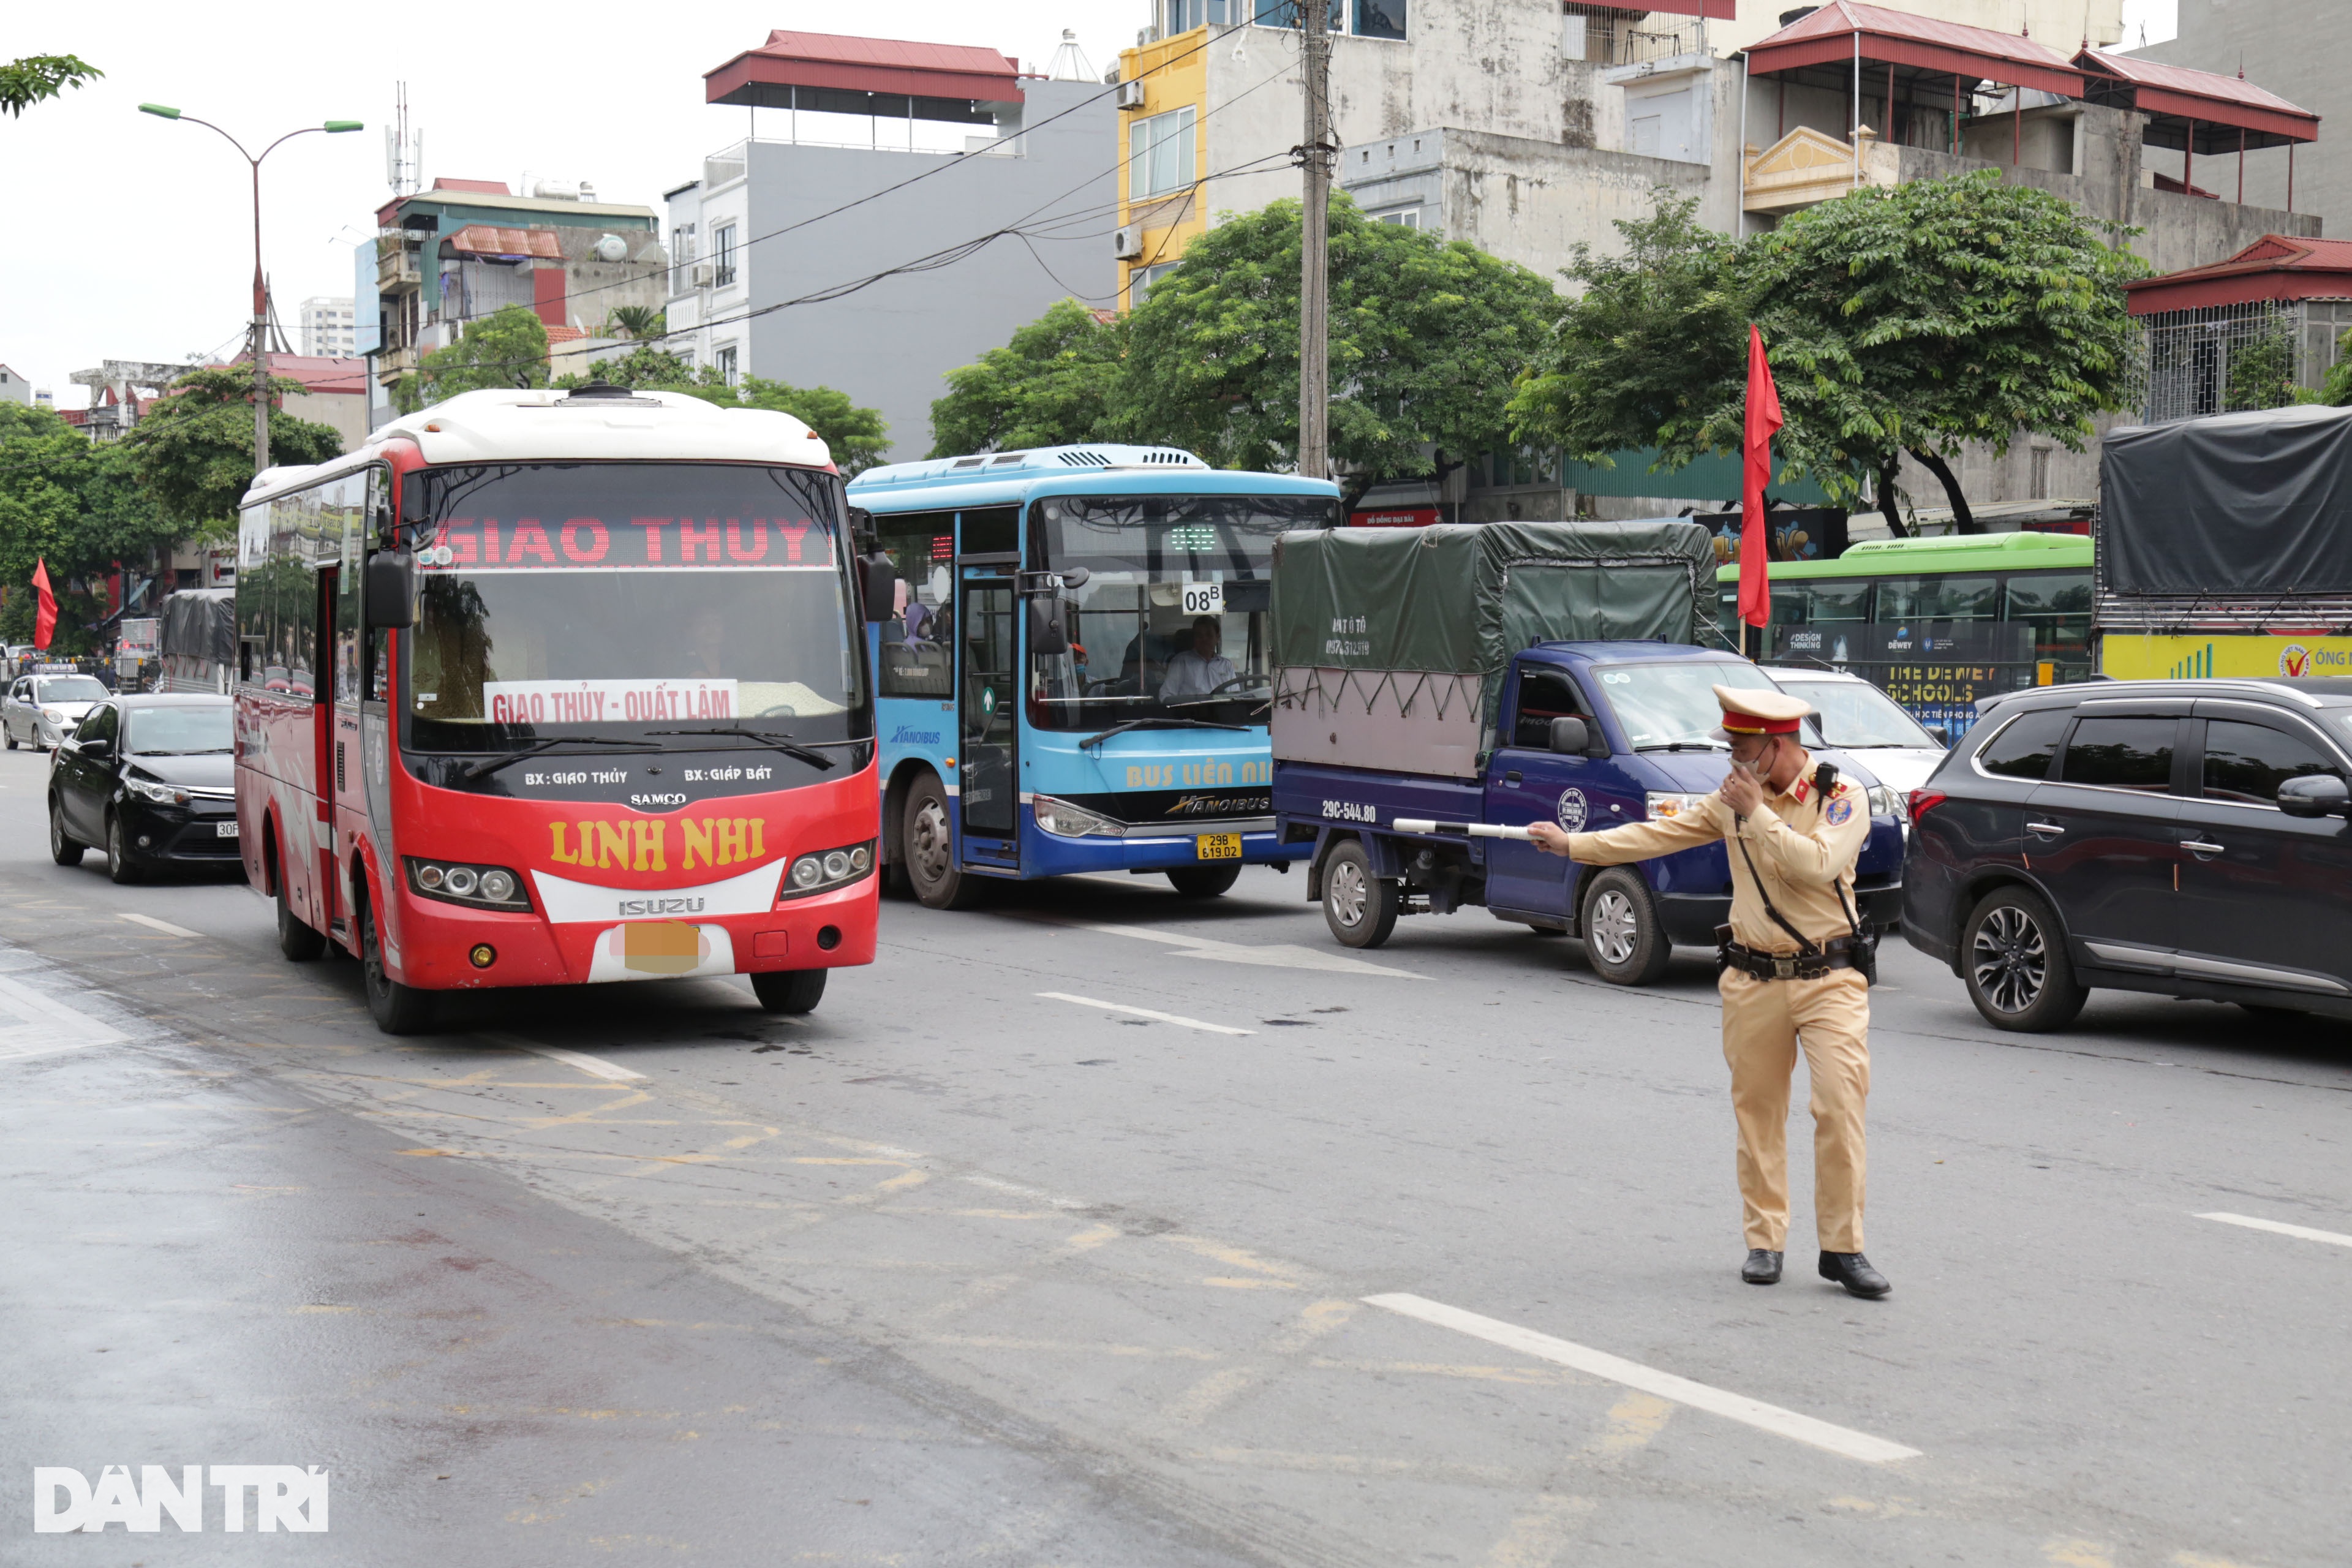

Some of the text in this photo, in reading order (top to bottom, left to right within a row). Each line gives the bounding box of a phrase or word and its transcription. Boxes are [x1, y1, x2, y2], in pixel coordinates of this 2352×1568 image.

[432, 515, 611, 565] GIAO
[2315, 647, 2345, 665] ỐNG
[493, 692, 545, 724] GIAO
[551, 681, 605, 723] THỦY
[685, 684, 731, 720] LÂM
[1887, 684, 1973, 703] SCHOOLS
[890, 725, 940, 744] HANOIBUS
[591, 767, 628, 785] THỦY
[746, 765, 772, 781] BÁT
[1126, 764, 1173, 788] BUS
[1183, 757, 1233, 785] LIÊN
[630, 794, 687, 805] SAMCO
[1165, 796, 1270, 814] HANOIBUS
[1322, 800, 1376, 823] 29C-544.80
[549, 818, 766, 872] LINH NHI
[1210, 835, 1228, 845] 29B
[619, 896, 704, 915] ISUZU
